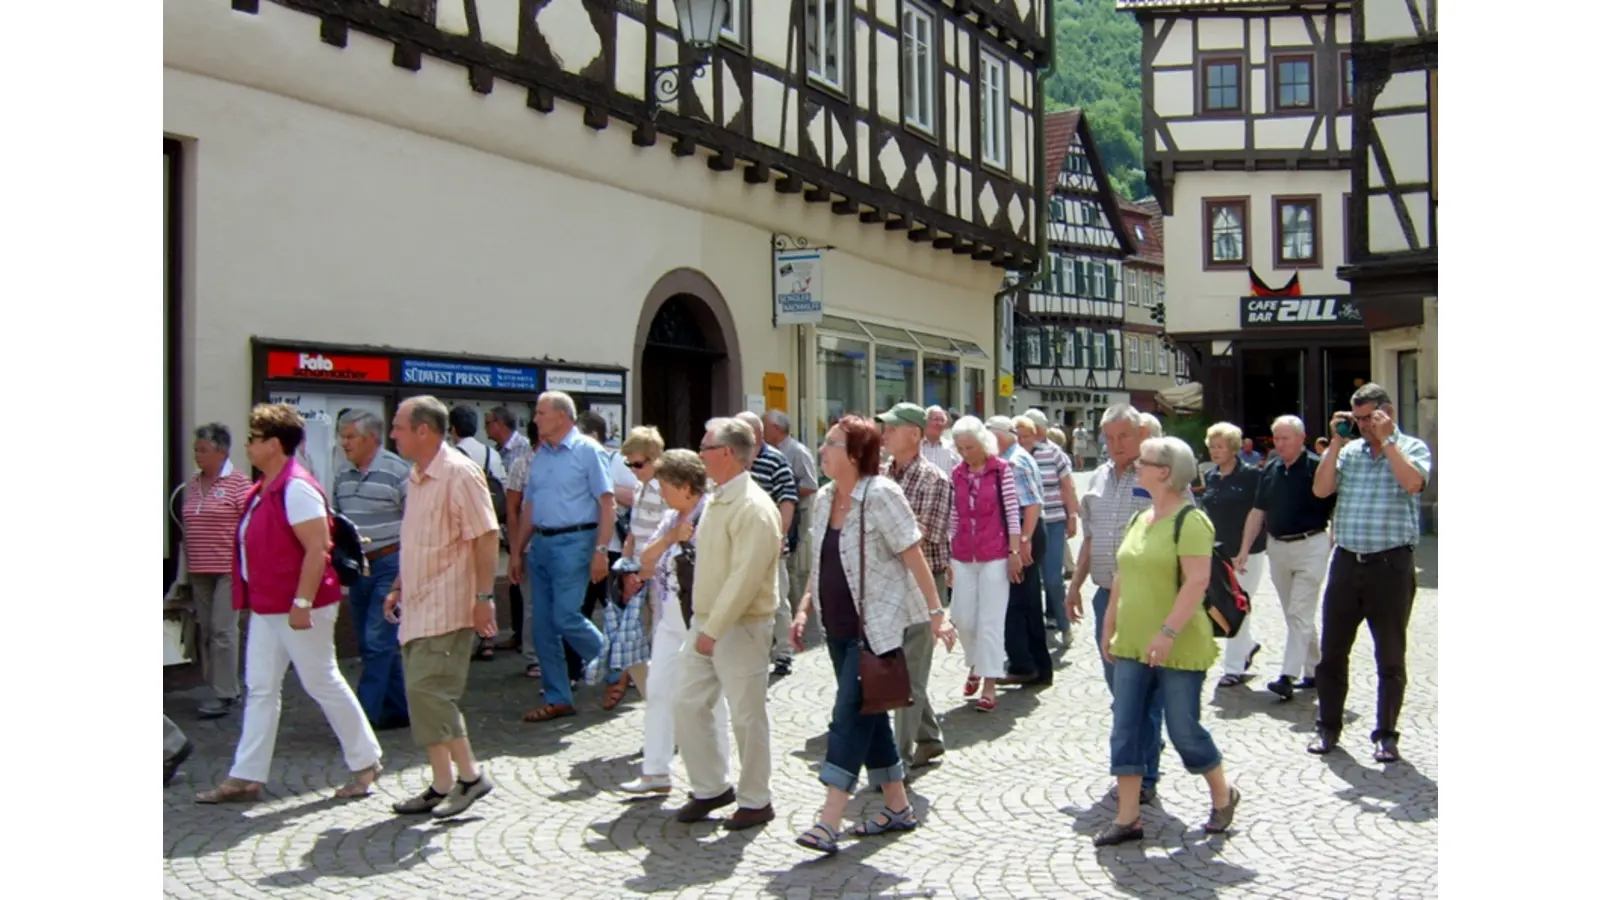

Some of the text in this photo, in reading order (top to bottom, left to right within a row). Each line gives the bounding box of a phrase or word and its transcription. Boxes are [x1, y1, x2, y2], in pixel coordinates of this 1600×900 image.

[1247, 300, 1278, 310] CAFE
[1277, 299, 1337, 321] ZILL
[1247, 312, 1273, 322] BAR
[299, 353, 333, 371] Foto
[404, 368, 453, 382] SÜDWEST
[455, 371, 492, 387] PRESSE
